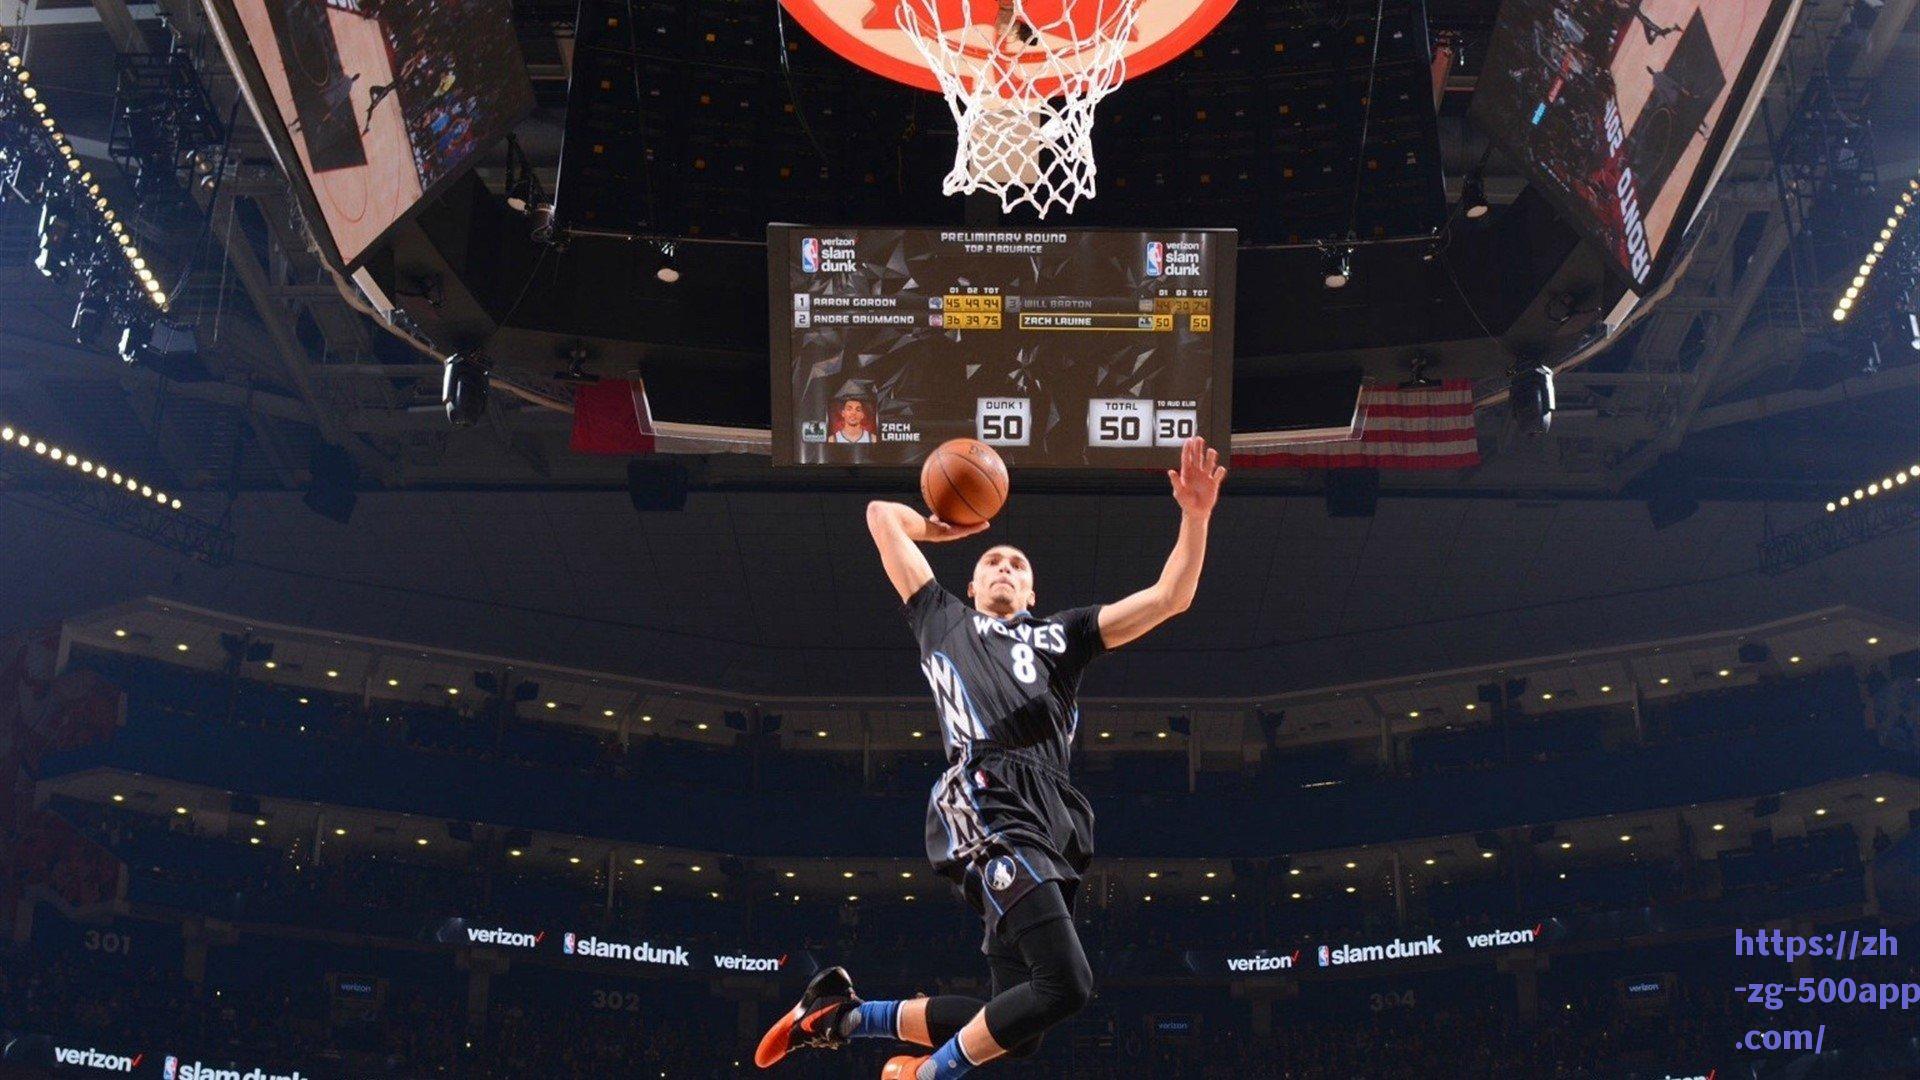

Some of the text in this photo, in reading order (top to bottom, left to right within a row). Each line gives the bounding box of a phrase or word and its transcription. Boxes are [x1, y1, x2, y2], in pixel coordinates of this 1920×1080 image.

[821, 238, 855, 246] verizon
[940, 232, 1067, 243] PRELIMINARY ROUND
[821, 246, 856, 259] slam
[965, 244, 984, 253] TOP
[986, 245, 993, 253] 2
[1166, 242, 1200, 250] verizon
[1165, 250, 1200, 263] slam
[821, 259, 857, 272] dunk
[1164, 263, 1200, 275] dunk
[813, 298, 850, 306] AARON
[853, 298, 897, 306] GORDON
[946, 299, 960, 308] 45
[965, 299, 980, 308] 49
[983, 299, 999, 308] 94
[1050, 300, 1092, 308] BARTON
[799, 315, 806, 324] 2
[814, 315, 850, 323] ANDRE
[852, 315, 915, 324] DRUMMOND
[965, 316, 980, 325] 39
[983, 316, 999, 325] 75
[1024, 317, 1052, 325] ZACH
[1156, 318, 1170, 327] 50
[1193, 318, 1208, 327] 50
[985, 401, 1015, 410] DUNK
[1105, 402, 1138, 411] TOTAL
[881, 422, 911, 432] ZACH
[983, 415, 1023, 440] 50
[1100, 416, 1140, 441] 50
[1160, 418, 1193, 439] 30
[1011, 643, 1037, 684] 8
[85, 930, 132, 955] 301
[467, 927, 536, 948] verizon
[1466, 929, 1534, 949] verizon
[576, 936, 690, 967] slam dunk
[1331, 934, 1443, 966] slam dunk
[714, 954, 780, 972] verizon
[1227, 955, 1292, 972] verizon
[54, 1047, 132, 1073] verizon
